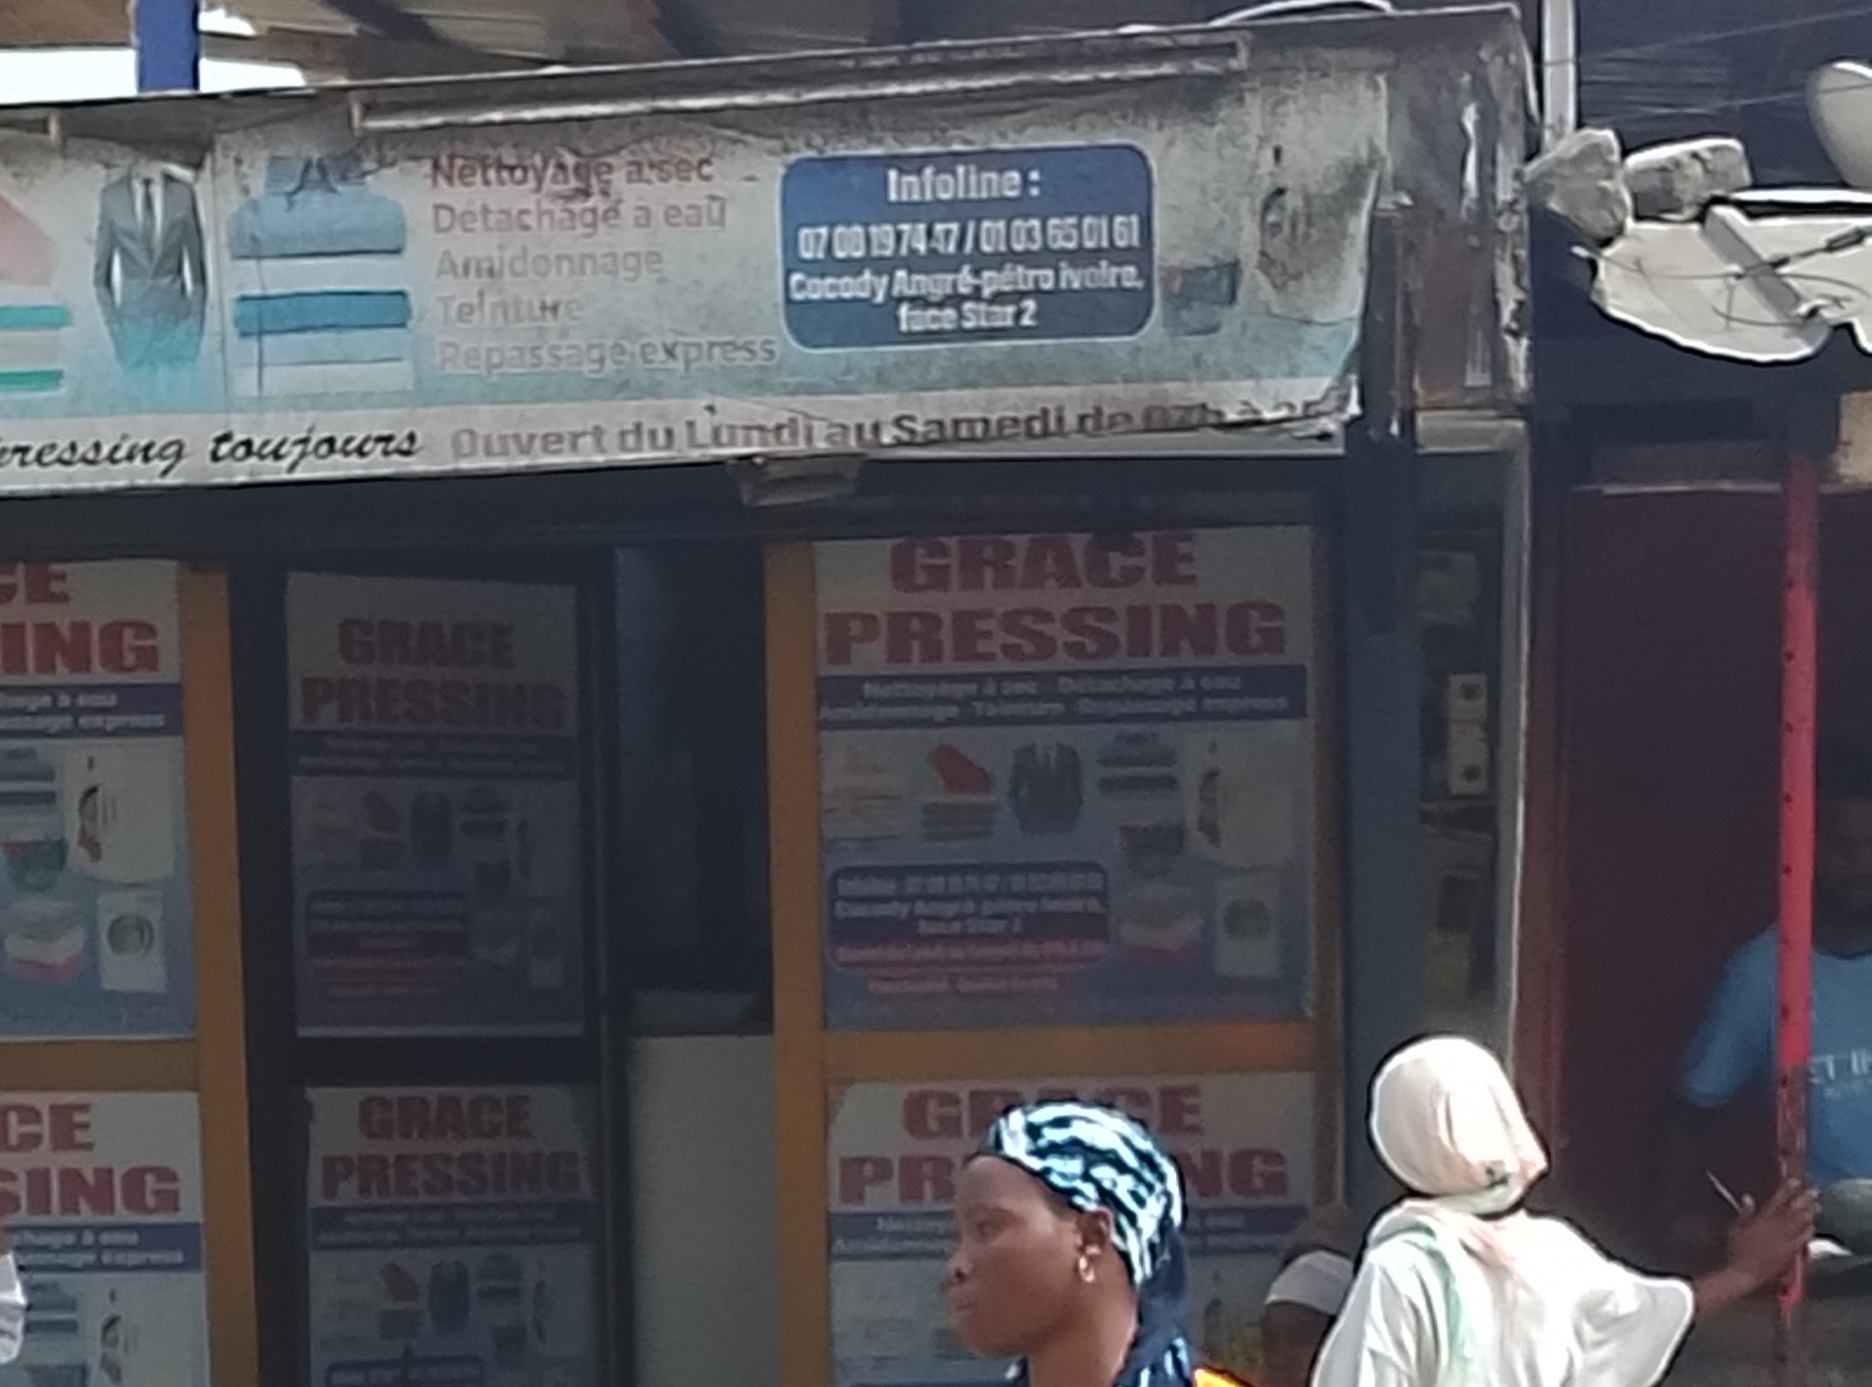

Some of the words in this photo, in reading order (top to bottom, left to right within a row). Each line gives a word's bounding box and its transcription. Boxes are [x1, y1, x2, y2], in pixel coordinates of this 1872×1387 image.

[656, 157, 714, 183] sec
[887, 165, 1022, 202] Infoline
[663, 202, 727, 229] eau
[435, 248, 664, 284] Amidonnage
[788, 267, 890, 304] Cocody
[896, 301, 958, 333] face
[960, 302, 1017, 330] Star
[1018, 299, 1039, 328] 2
[439, 338, 632, 376] Repassage
[638, 336, 778, 373] express
[208, 423, 424, 474] toujours
[450, 424, 607, 459] Ouvert
[616, 418, 675, 453] du
[684, 412, 813, 450] Lundi
[890, 405, 1065, 445] Samedi
[889, 530, 1199, 593] GRACE
[336, 617, 516, 670] GRACE
[824, 601, 1287, 666] PRESSING
[301, 676, 565, 728] PRESSING
[356, 1094, 534, 1141] GRACE
[322, 1150, 582, 1199] PRESSING
